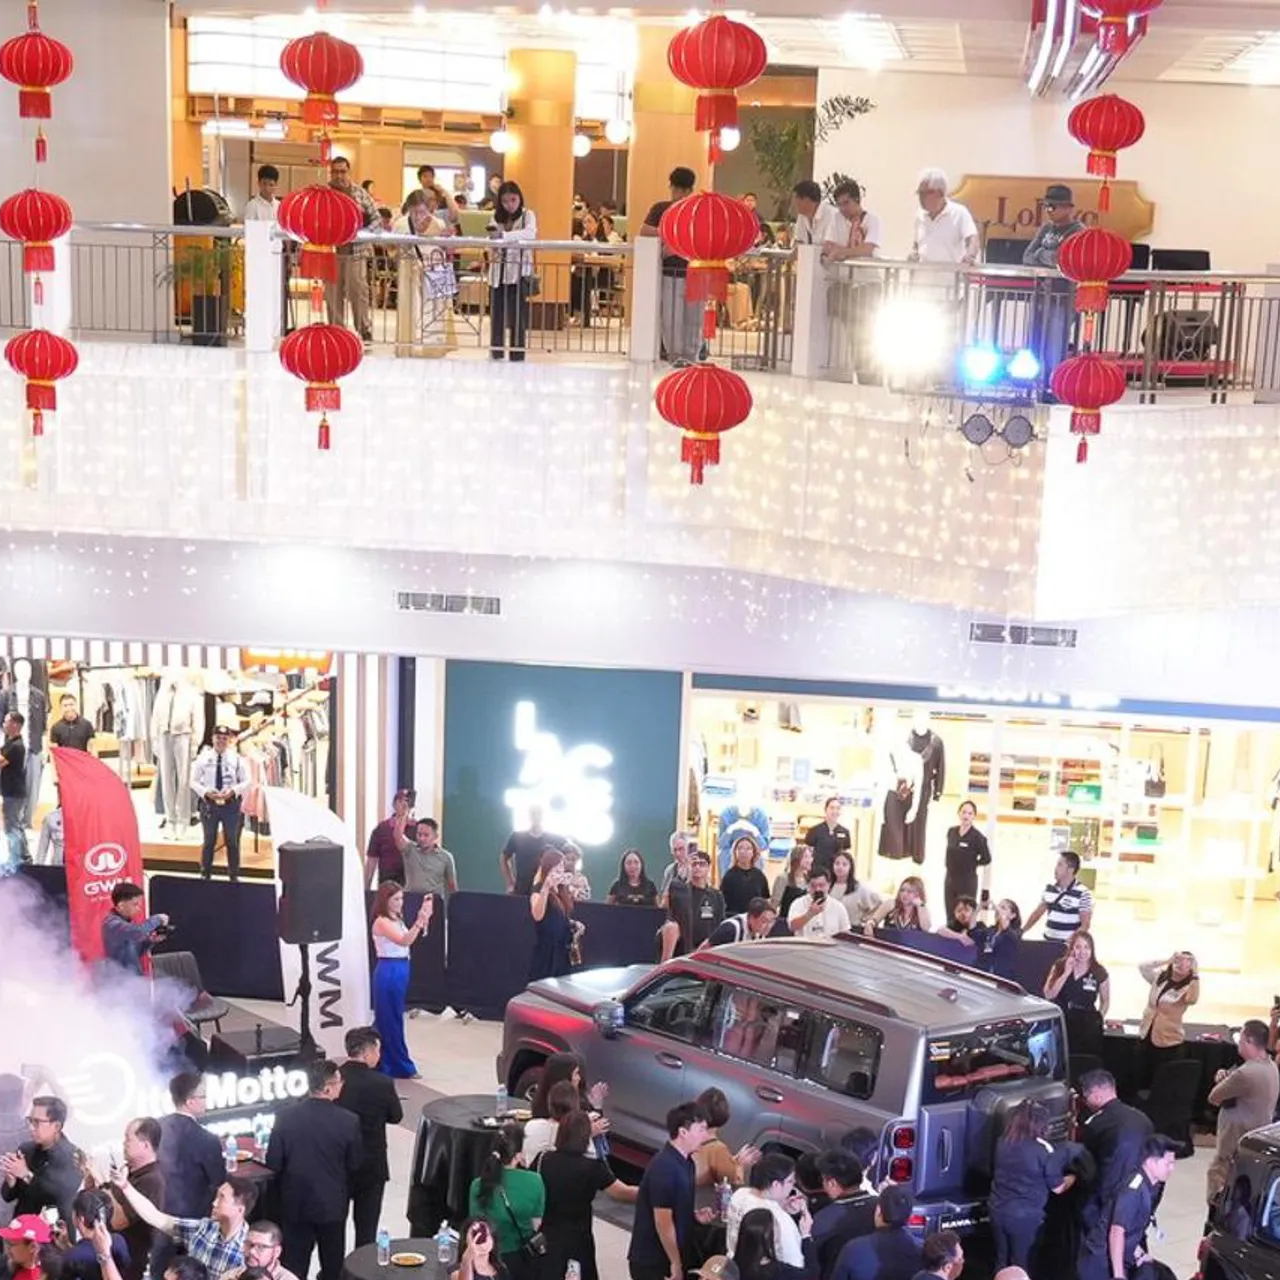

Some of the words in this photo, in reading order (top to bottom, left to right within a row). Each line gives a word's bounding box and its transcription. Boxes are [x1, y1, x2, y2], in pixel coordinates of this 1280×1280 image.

[83, 876, 133, 897] GW
[316, 941, 344, 1029] WM
[206, 1064, 310, 1110] Motto
